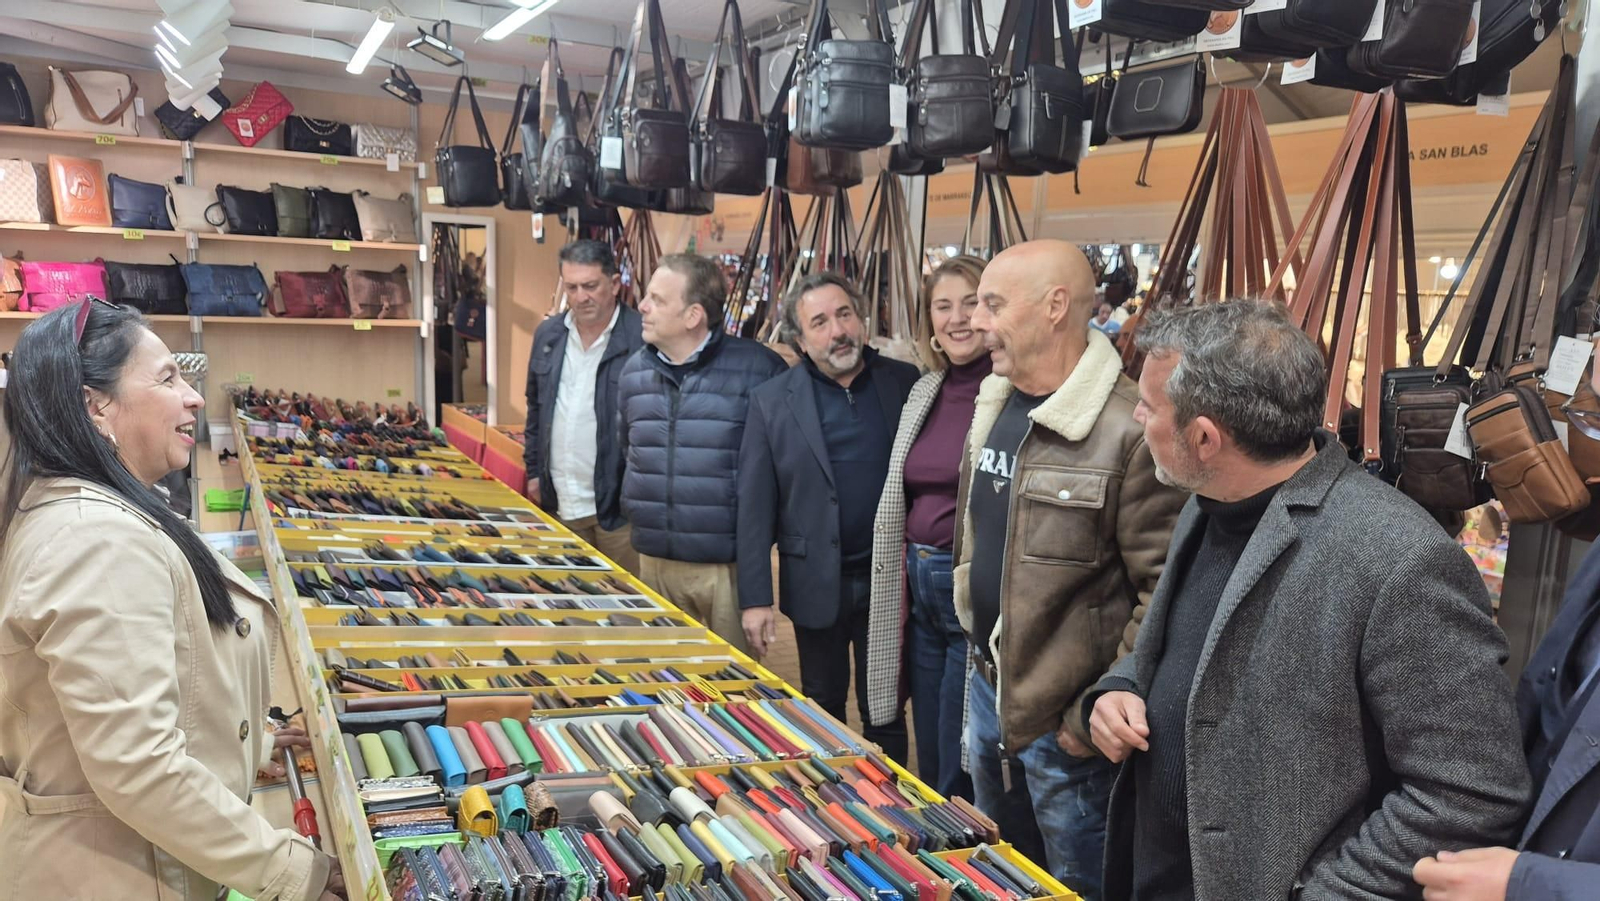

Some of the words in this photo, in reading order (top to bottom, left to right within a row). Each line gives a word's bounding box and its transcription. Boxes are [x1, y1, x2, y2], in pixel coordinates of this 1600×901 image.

[98, 135, 115, 143] 70€
[1420, 147, 1447, 160] SAN
[1451, 143, 1488, 158] BLAS
